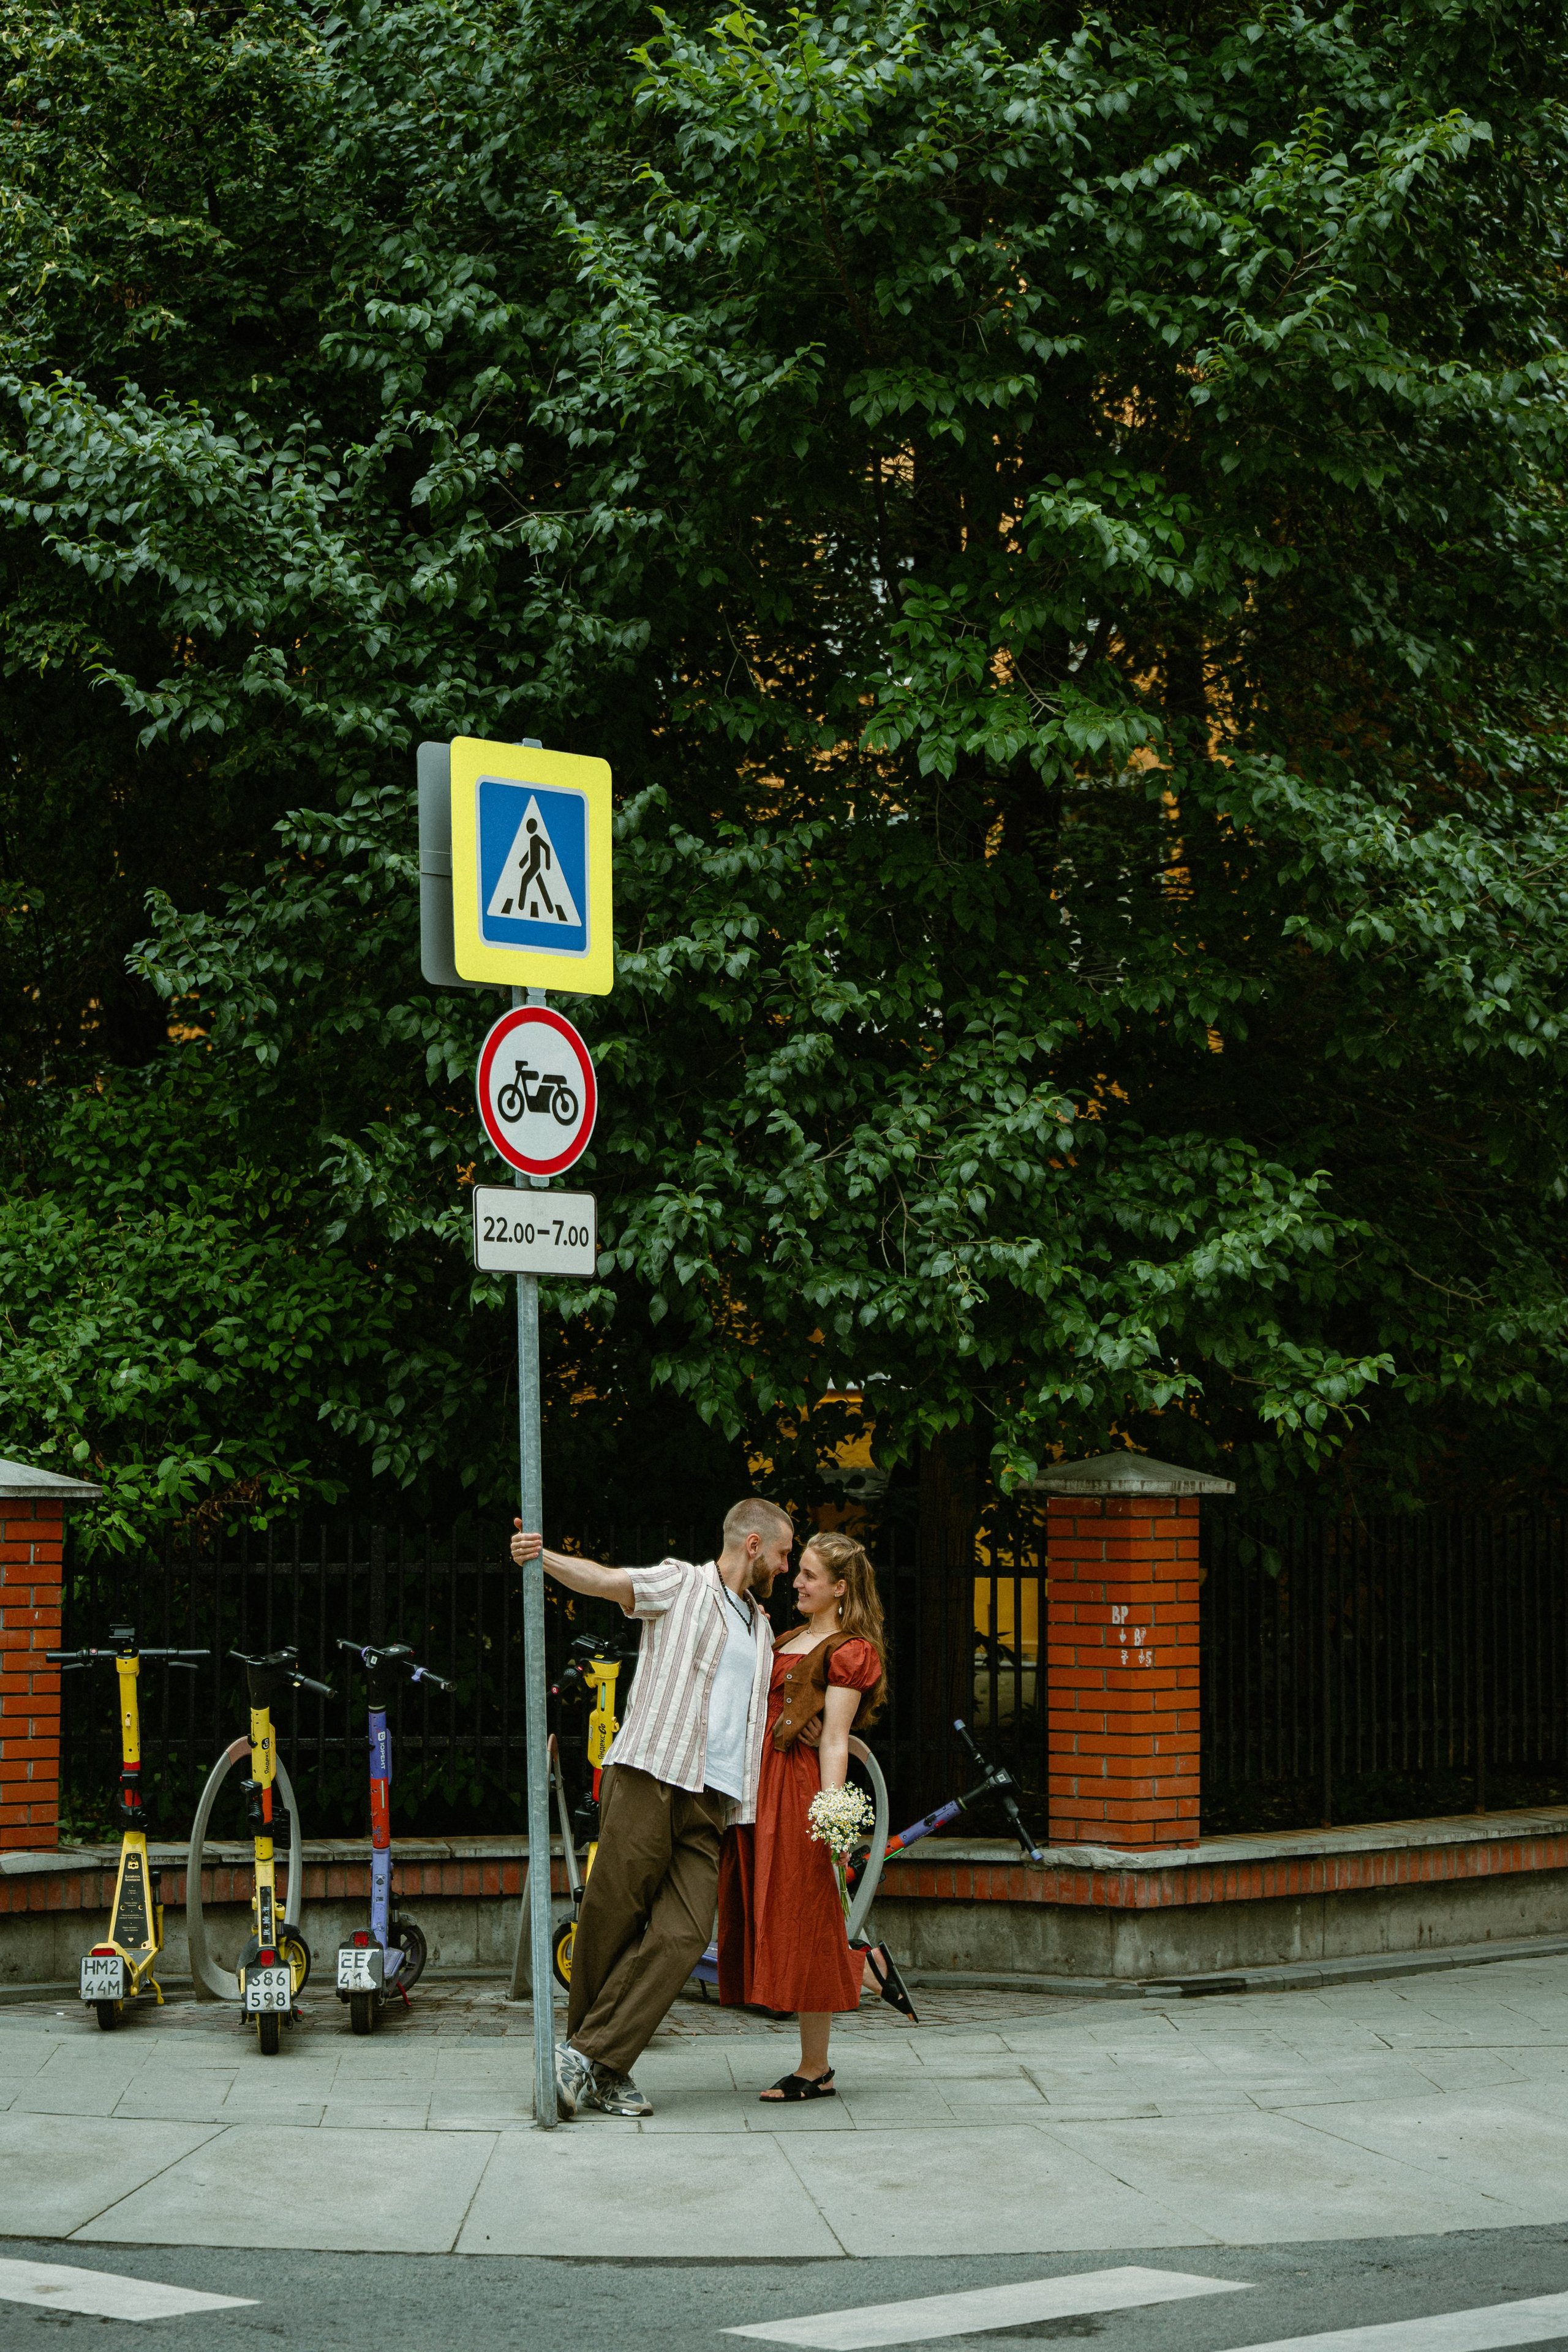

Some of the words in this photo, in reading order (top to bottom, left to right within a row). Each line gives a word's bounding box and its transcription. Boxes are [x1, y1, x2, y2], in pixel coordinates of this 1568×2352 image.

[483, 1216, 589, 1247] 22.00-7.00
[598, 1723, 606, 1735] Go
[262, 1738, 270, 1749] Go
[251, 1991, 286, 2007] 598
